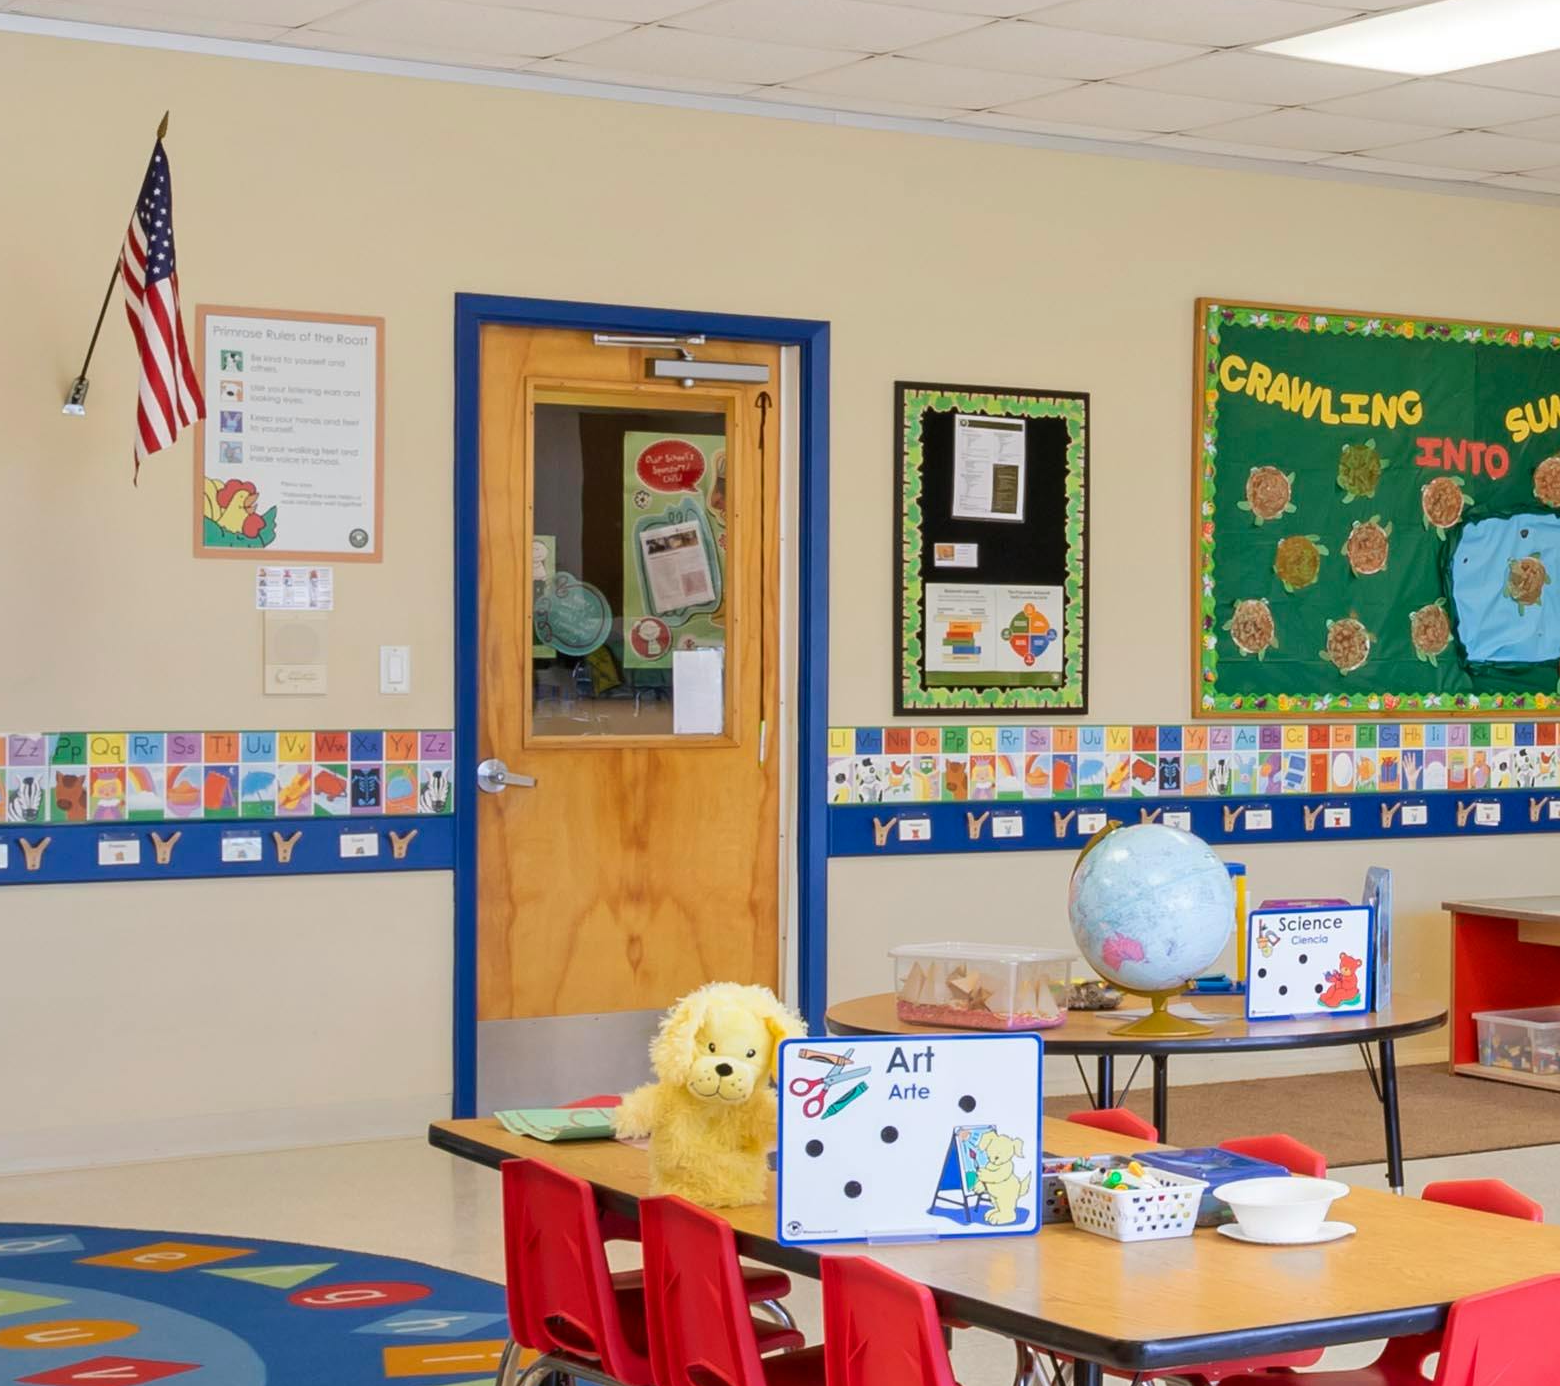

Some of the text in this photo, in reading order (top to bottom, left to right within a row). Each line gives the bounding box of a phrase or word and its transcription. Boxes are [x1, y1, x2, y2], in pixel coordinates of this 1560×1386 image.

[213, 325, 369, 346] Primrose Rules of the Roost
[263, 354, 282, 363] kind
[328, 359, 346, 367] and
[267, 386, 287, 395] your
[342, 389, 361, 397] and
[1219, 354, 1423, 429] CRAWLING
[275, 416, 294, 425] your
[323, 418, 341, 426] and
[340, 448, 360, 457] and
[1415, 437, 1509, 480] INTO
[13, 737, 40, 759] Zz
[90, 734, 447, 764] Qq Rr Ss Uu Yy Zz
[1278, 916, 1343, 932] Science
[1291, 934, 1328, 946] Ciencia
[886, 1045, 935, 1075] Art
[888, 1083, 931, 1101] Arte
